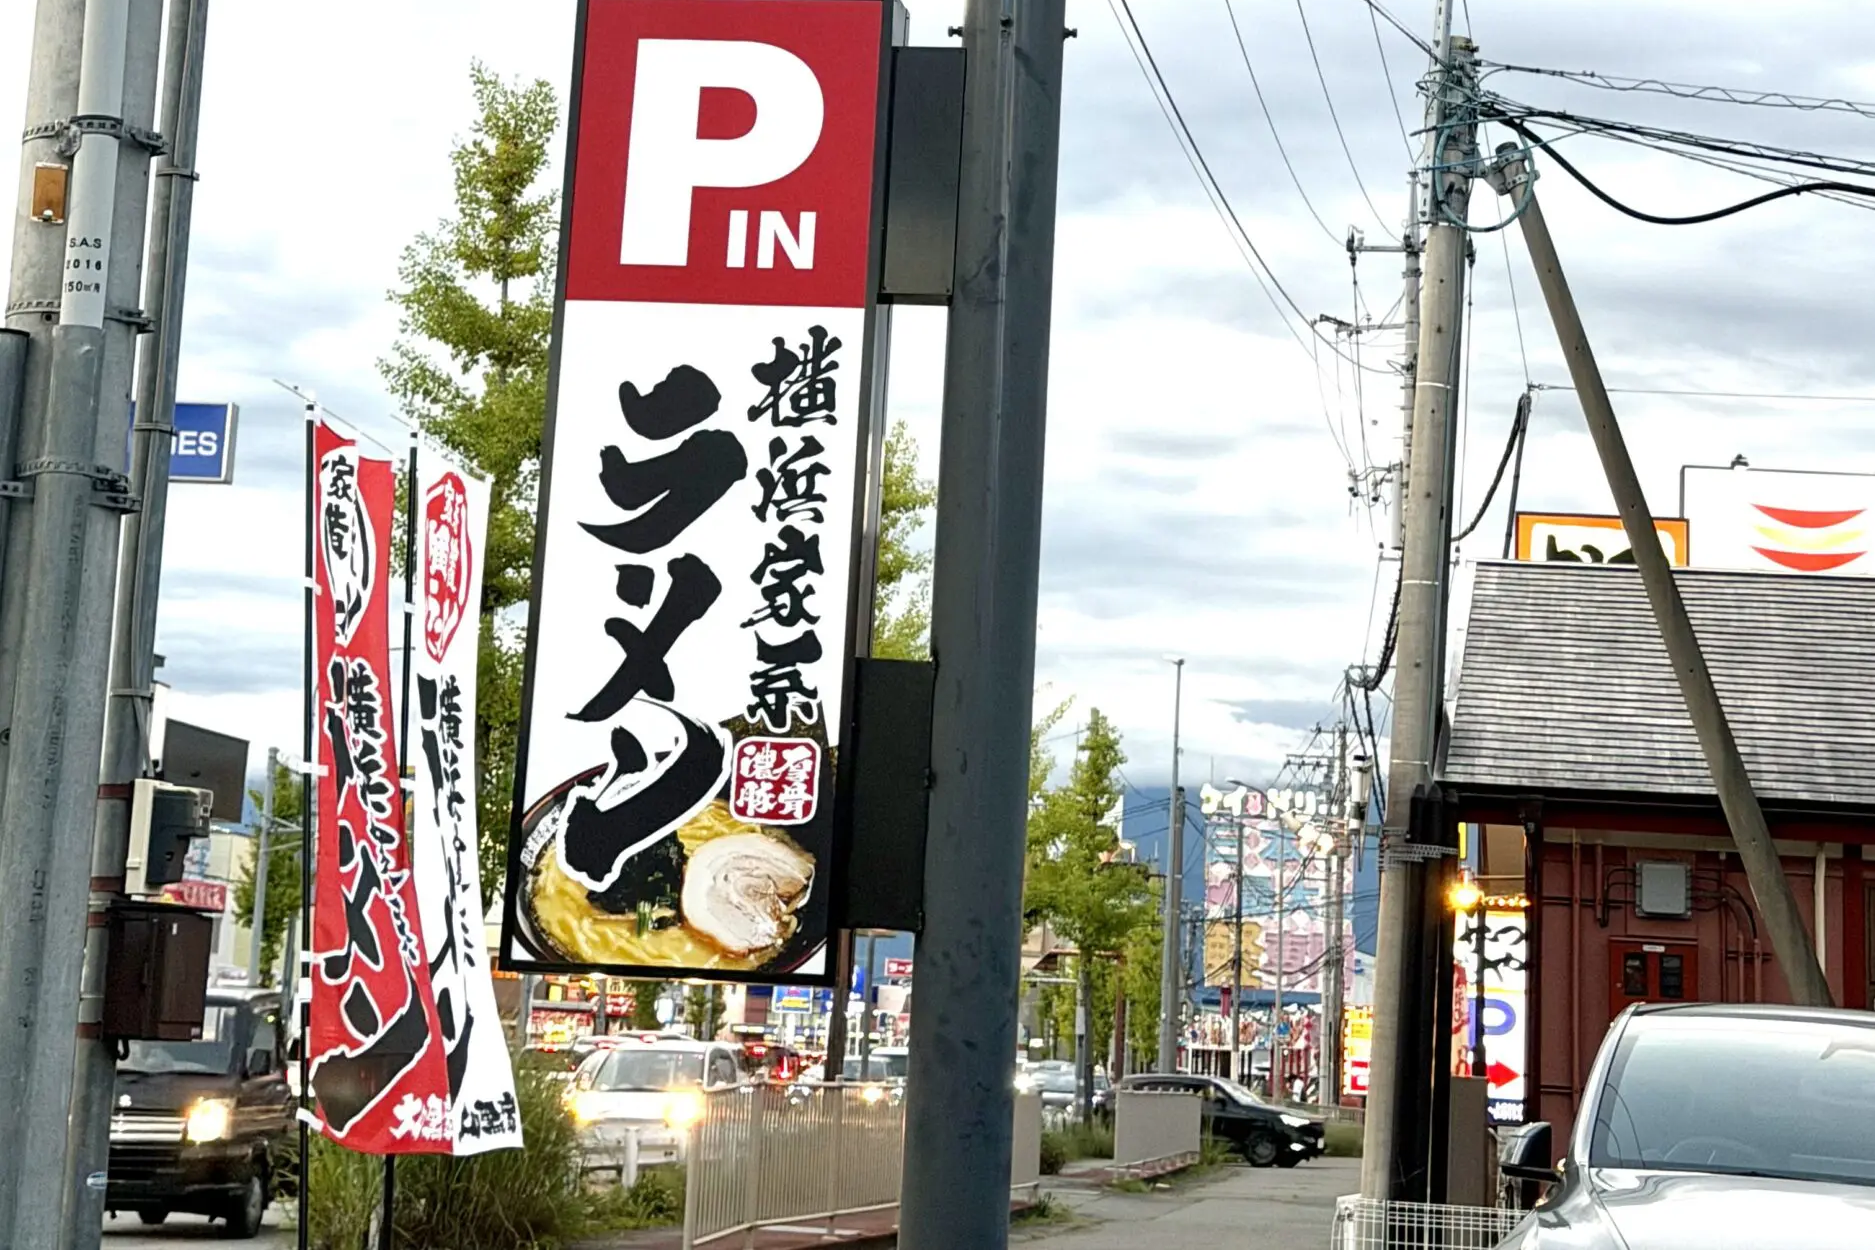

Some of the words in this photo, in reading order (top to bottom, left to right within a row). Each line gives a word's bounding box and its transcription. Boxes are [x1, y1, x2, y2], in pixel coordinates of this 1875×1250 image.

[620, 38, 824, 266] P
[726, 210, 817, 270] IN
[170, 431, 218, 456] ES
